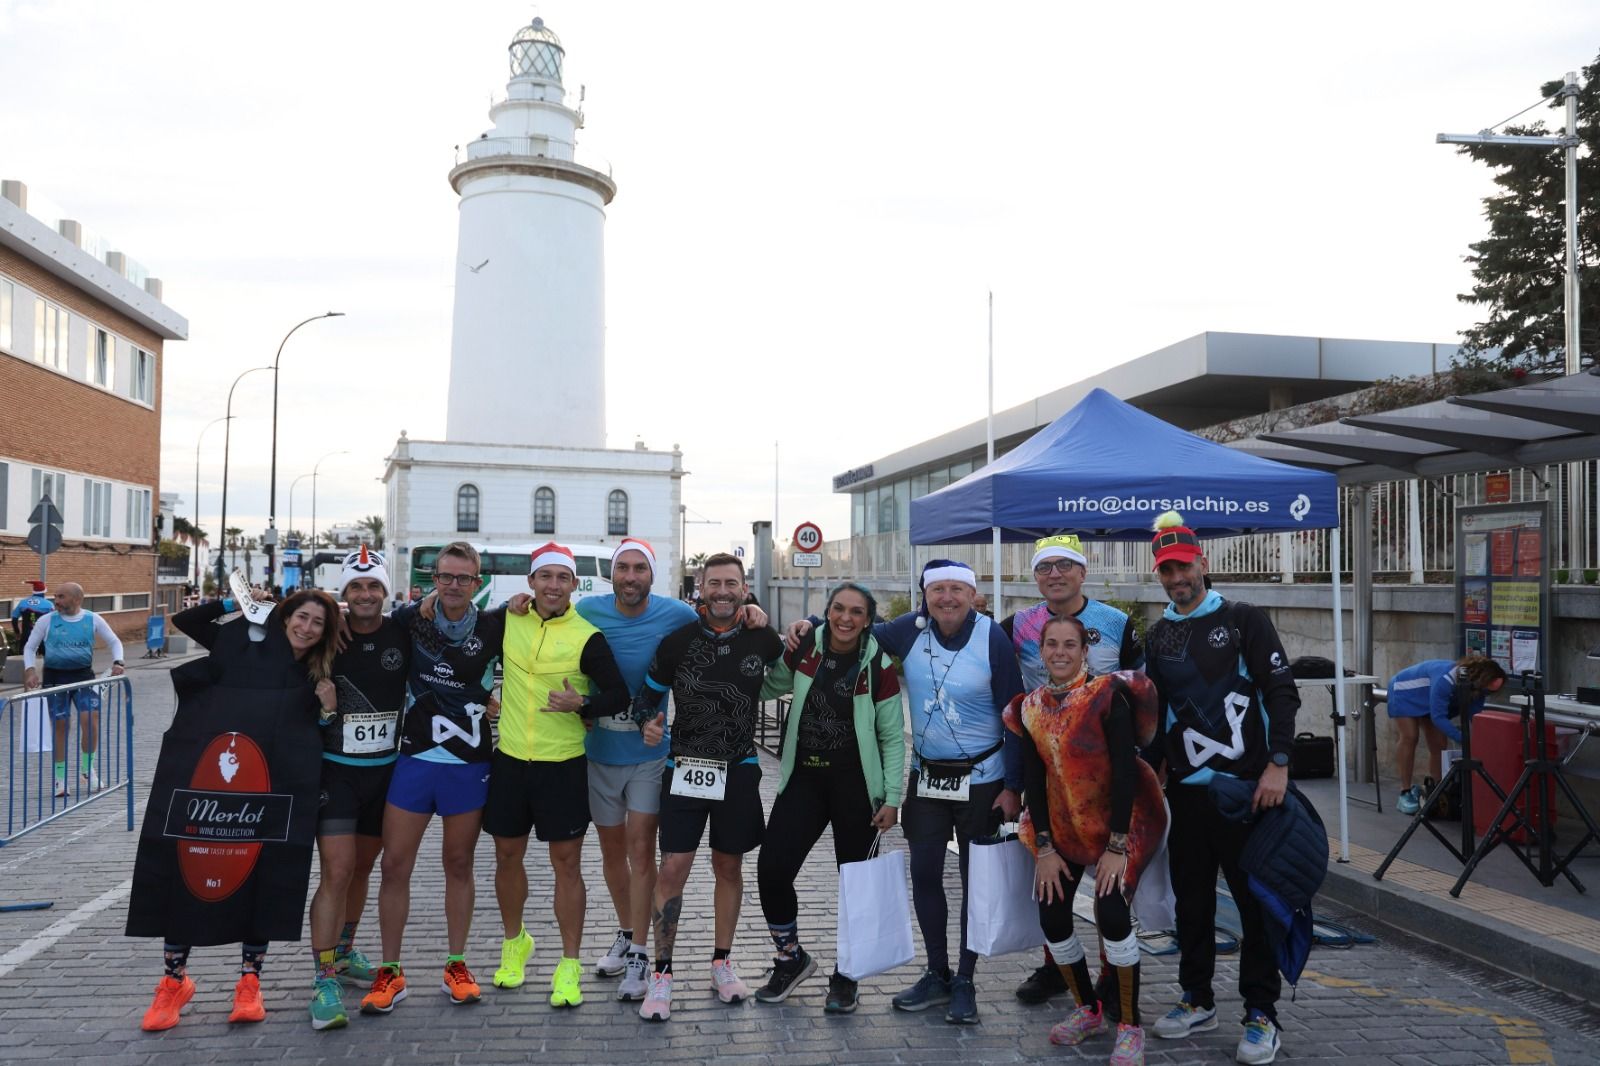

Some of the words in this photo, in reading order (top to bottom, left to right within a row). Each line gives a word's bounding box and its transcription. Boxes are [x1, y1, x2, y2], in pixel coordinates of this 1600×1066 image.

[1057, 495, 1270, 515] info@dorsalchip.es
[800, 531, 816, 543] 40
[420, 672, 466, 689] HISPAMAROC
[354, 723, 388, 742] 614
[683, 769, 716, 787] 489
[926, 774, 961, 792] 1420
[187, 798, 266, 824] Merlot
[185, 825, 198, 835] RED
[199, 826, 215, 836] WINE
[215, 827, 256, 837] COLLECTION
[188, 846, 209, 855] UNIQUE
[209, 847, 226, 856] TASTE
[226, 848, 234, 856] OF
